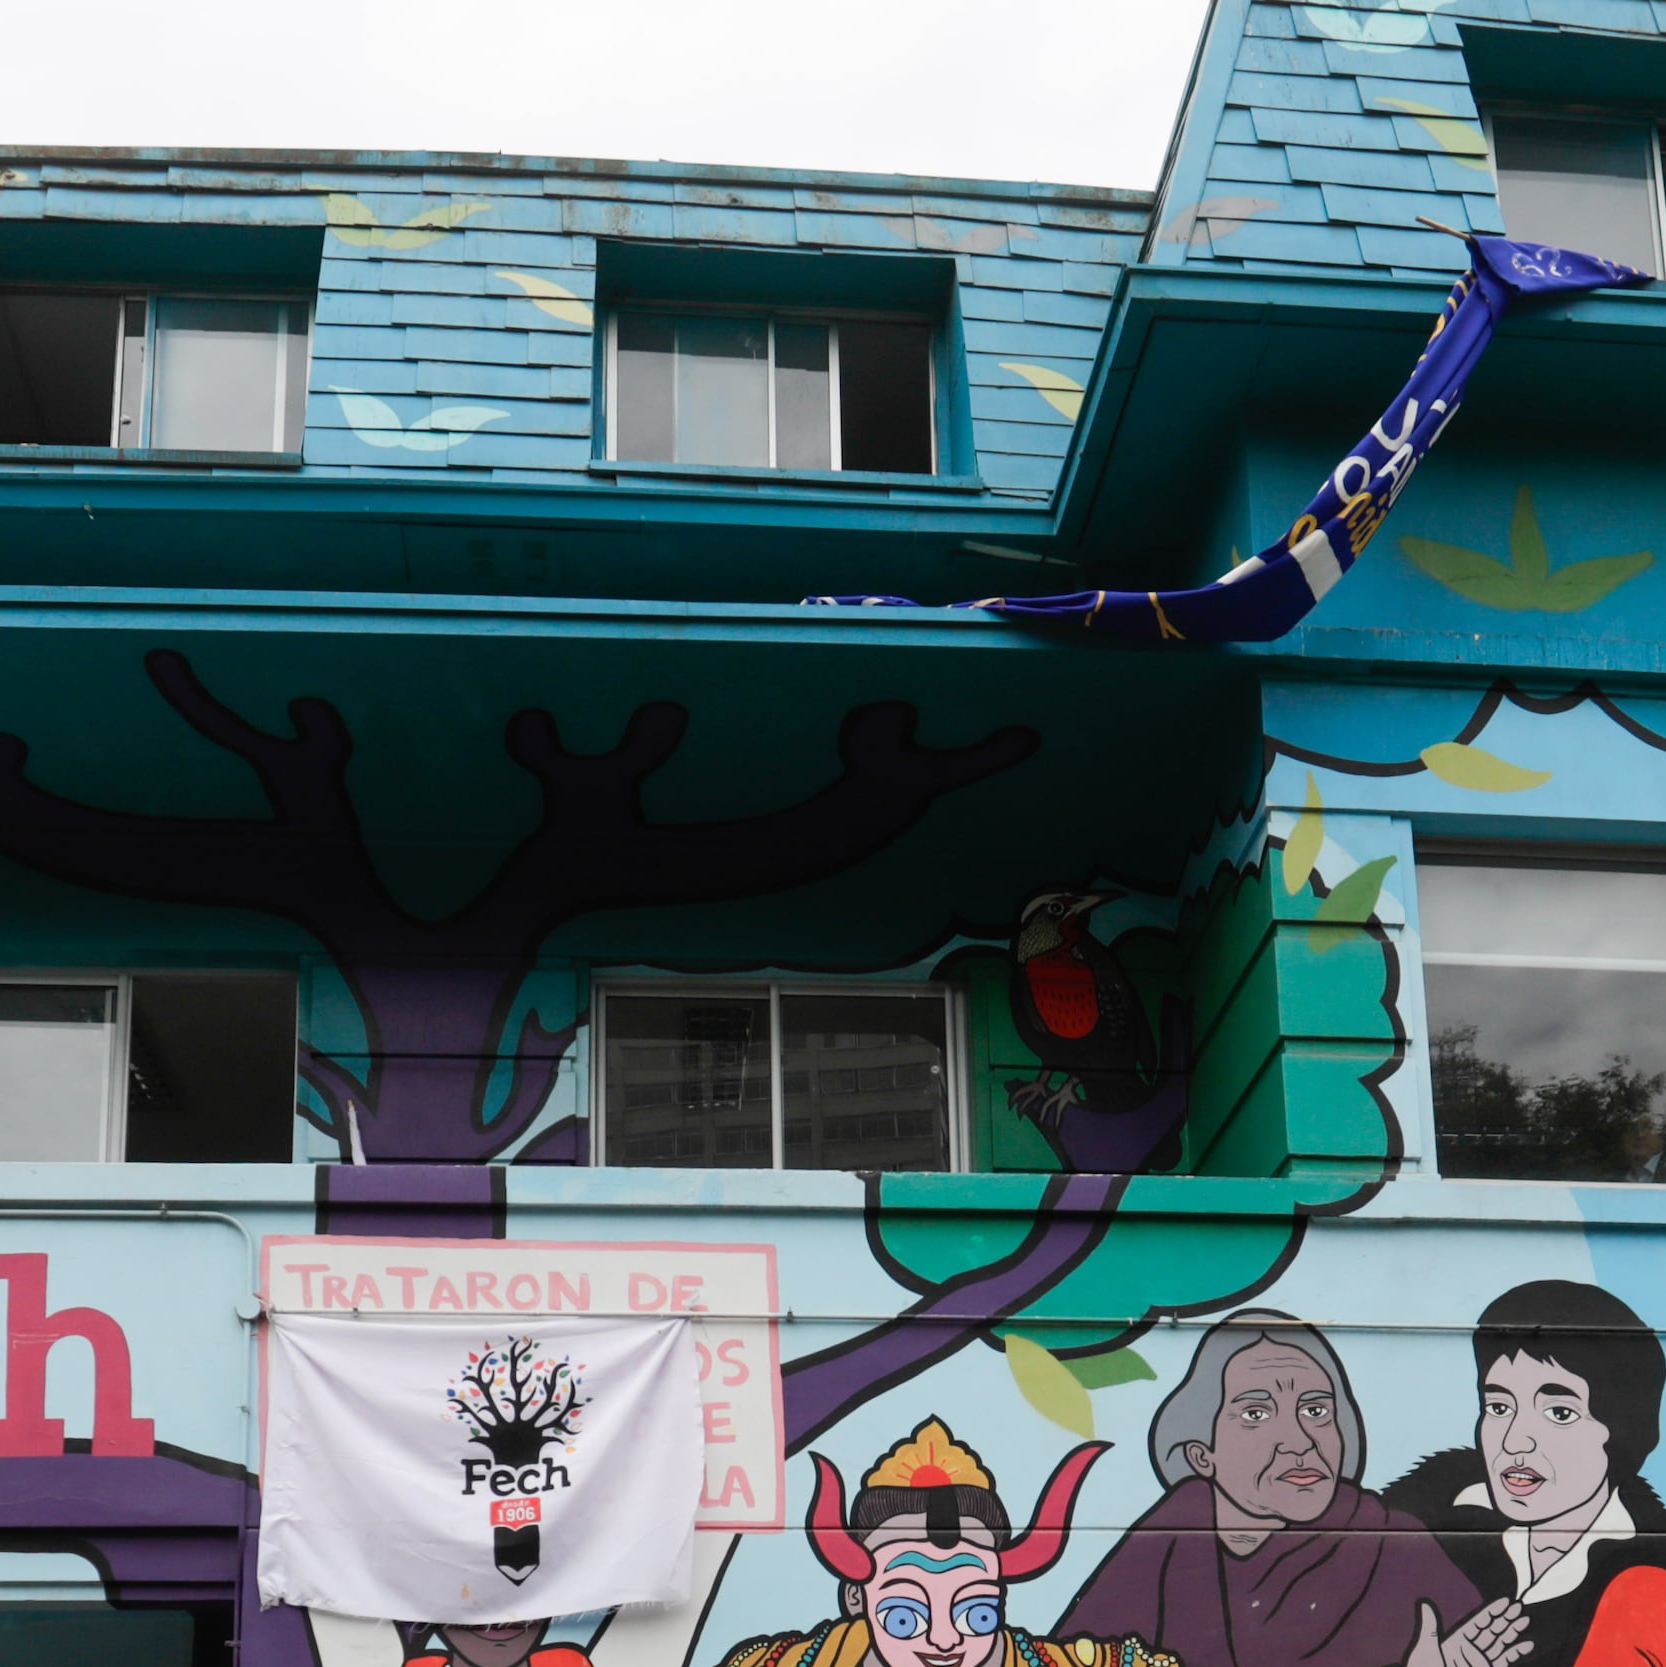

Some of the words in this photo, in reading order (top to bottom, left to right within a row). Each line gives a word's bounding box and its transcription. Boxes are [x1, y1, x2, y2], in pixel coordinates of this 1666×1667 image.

[284, 1263, 591, 1312] TRATARON
[627, 1272, 709, 1313] DE
[460, 1457, 571, 1496] Fech
[496, 1507, 536, 1522] 1906
